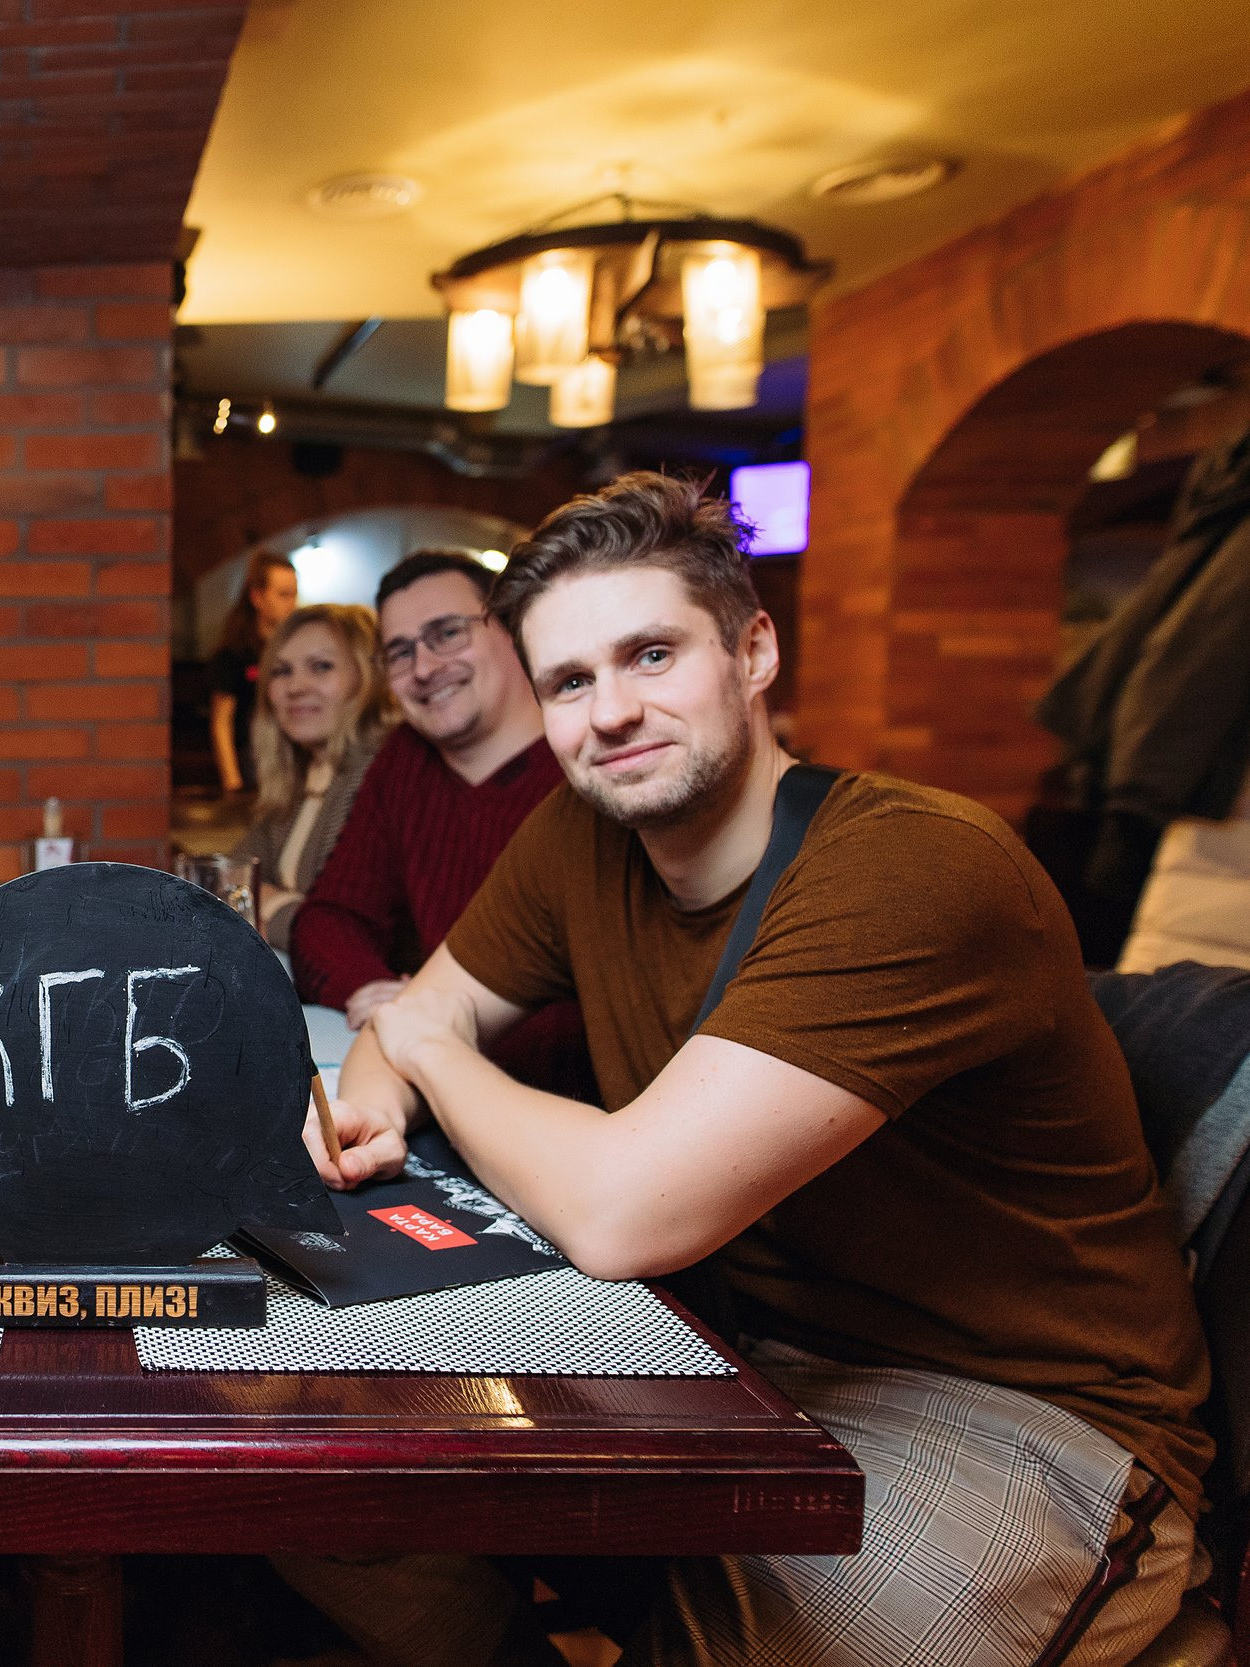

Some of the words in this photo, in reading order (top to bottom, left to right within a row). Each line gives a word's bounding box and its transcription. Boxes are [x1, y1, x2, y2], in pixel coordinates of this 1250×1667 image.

[389, 1213, 441, 1242] КАРТА
[410, 1212, 454, 1237] БАРА
[95, 1284, 199, 1318] ПЛИЗ!
